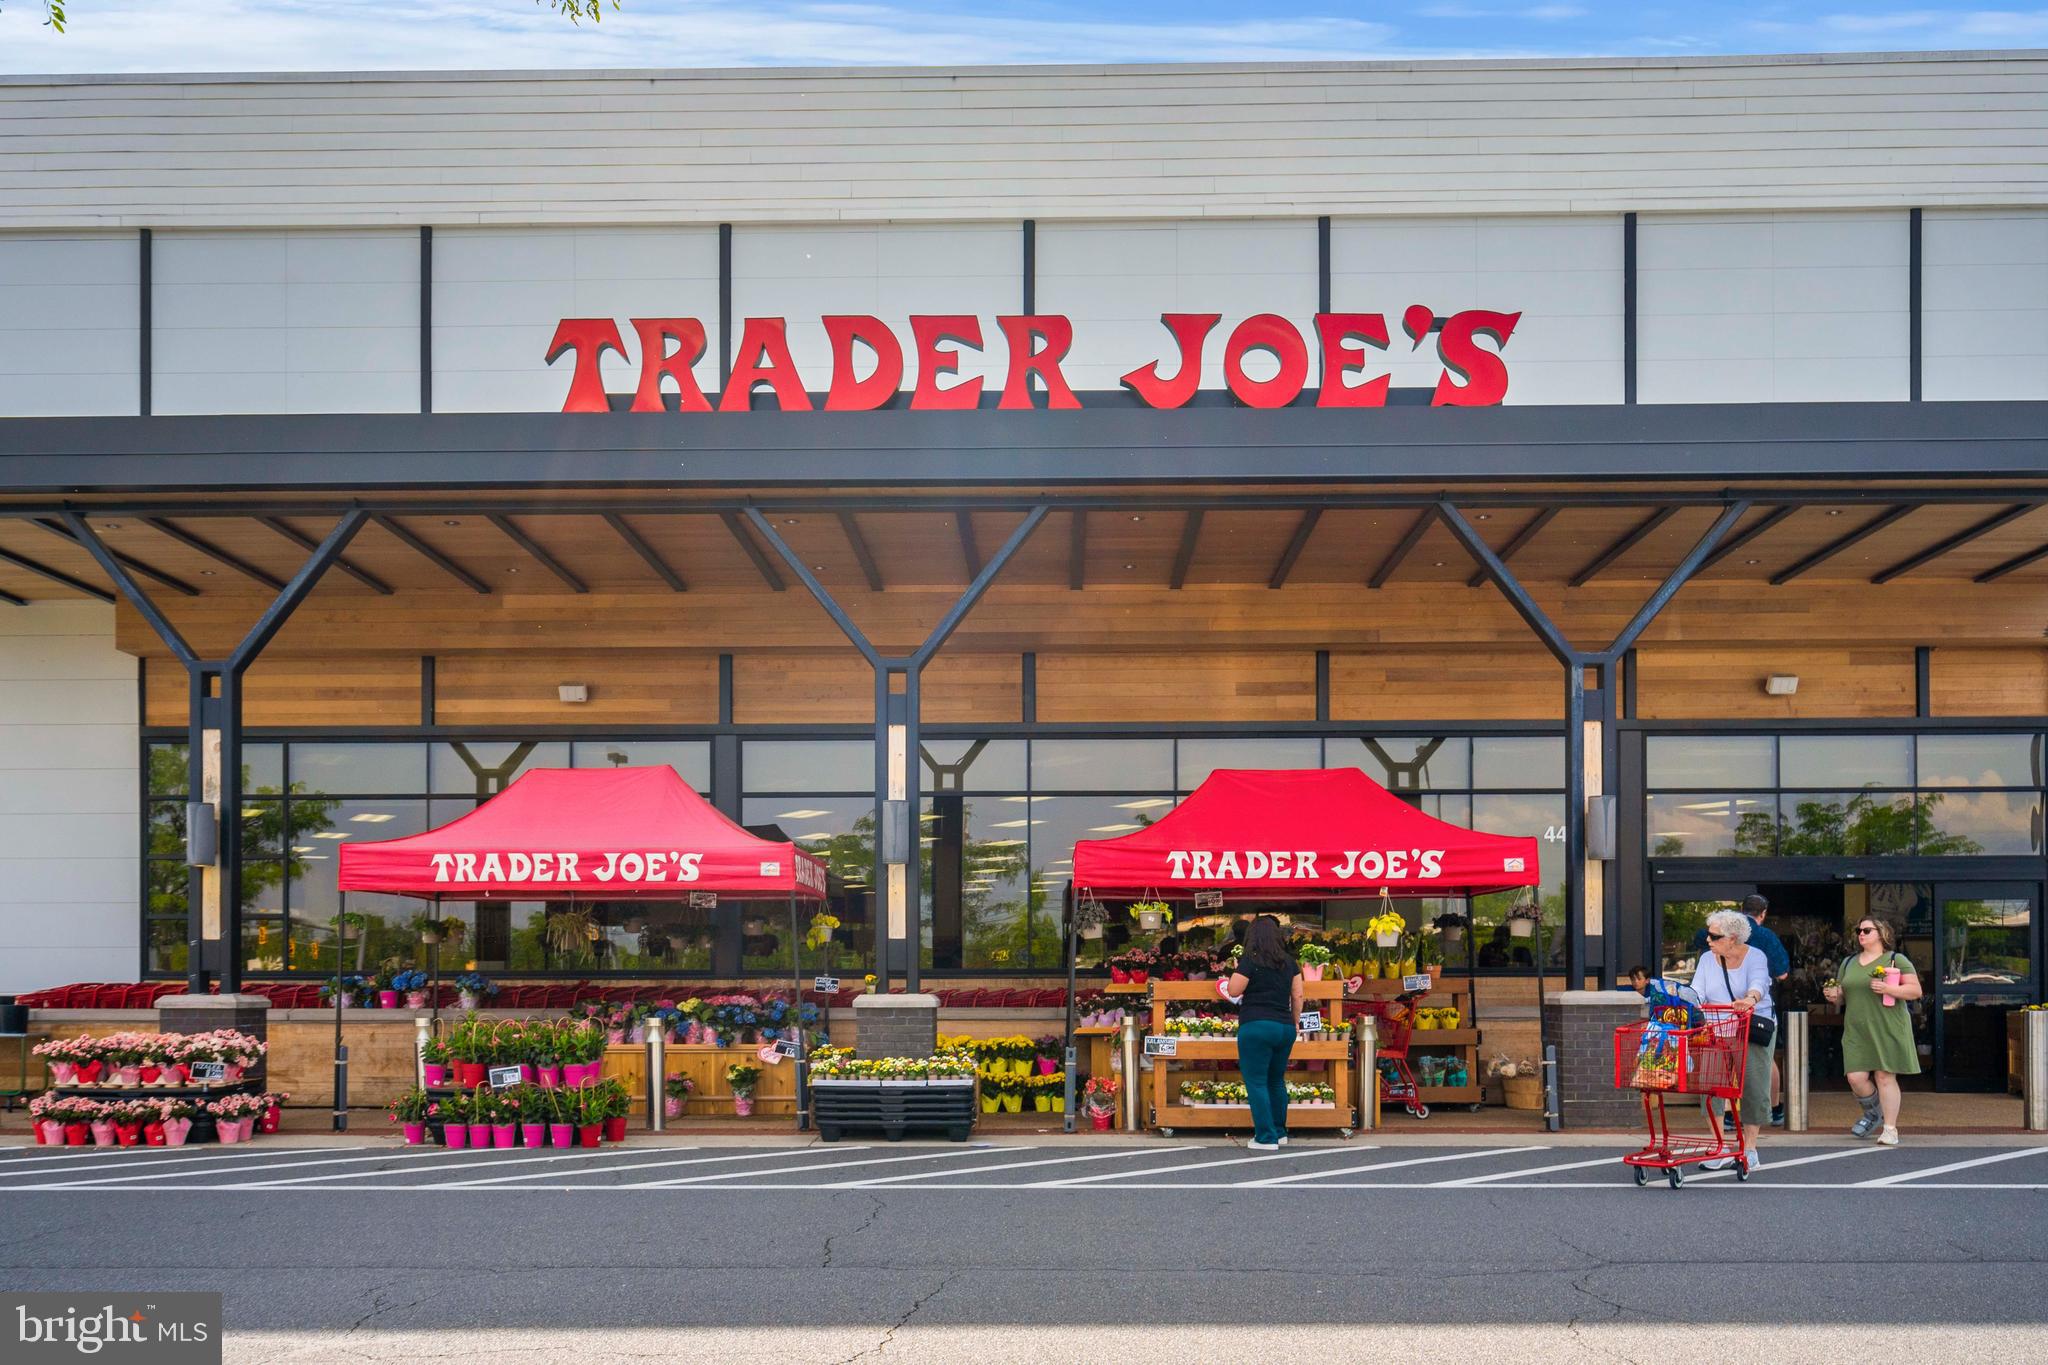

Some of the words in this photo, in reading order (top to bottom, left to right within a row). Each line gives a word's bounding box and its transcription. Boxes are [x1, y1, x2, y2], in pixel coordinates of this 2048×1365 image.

[544, 314, 1084, 413] TRADER
[1120, 304, 1522, 409] JOE'S
[431, 853, 581, 882] TRADER
[592, 852, 703, 882] JOE'S
[1166, 851, 1320, 879] TRADER
[1332, 848, 1445, 879] JOE'S
